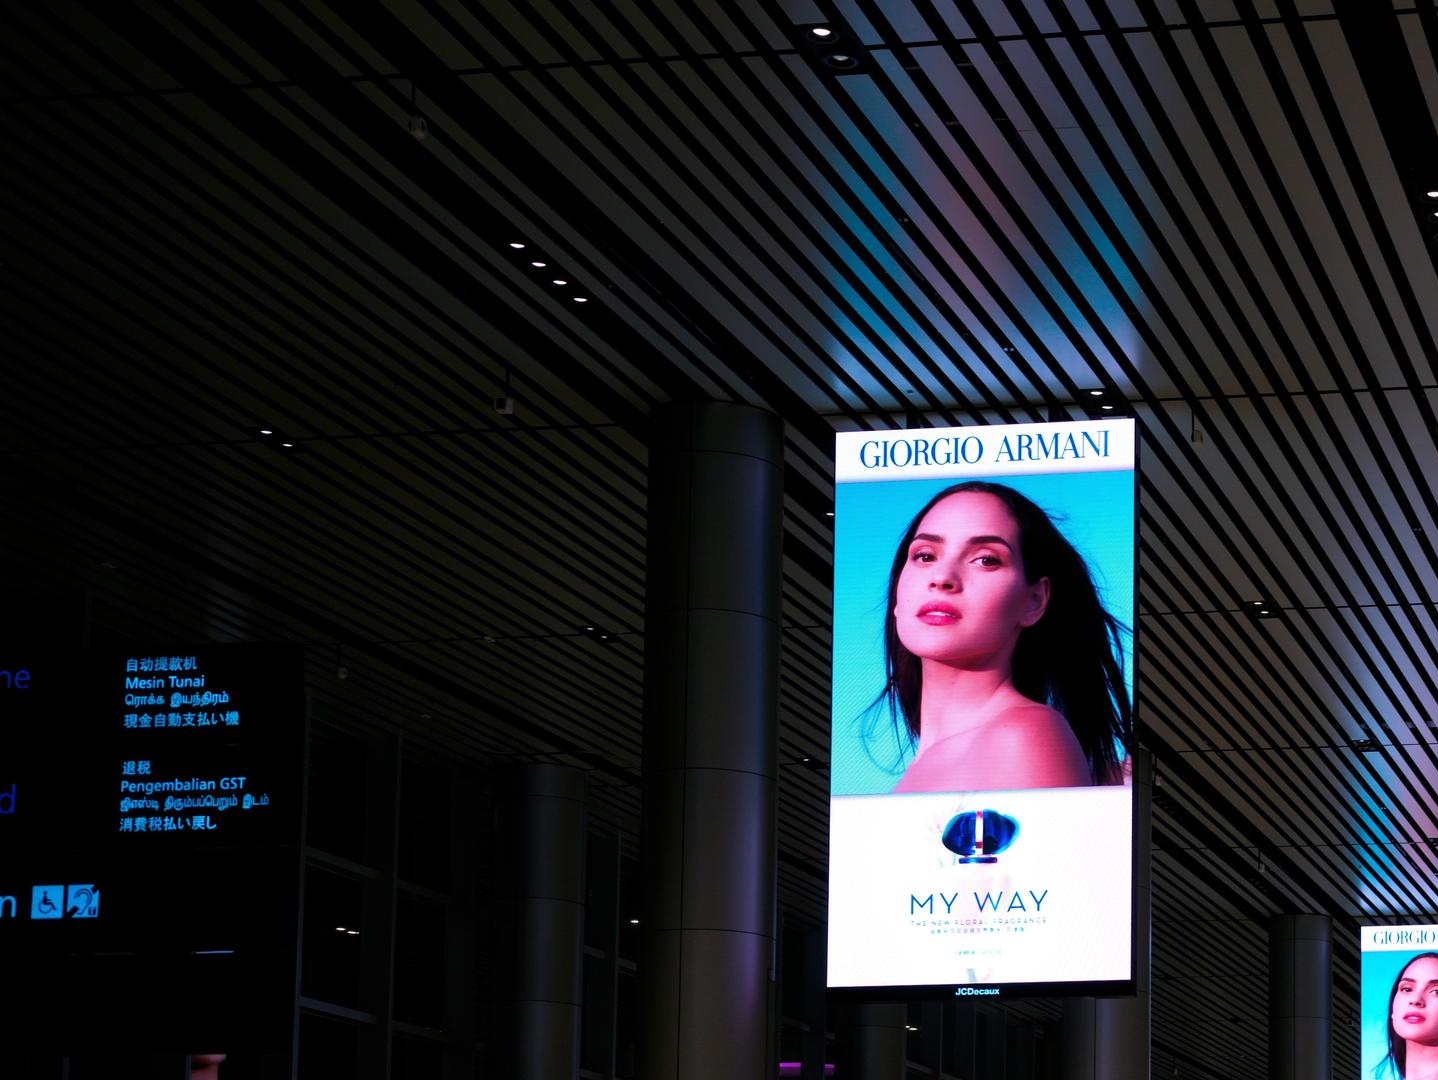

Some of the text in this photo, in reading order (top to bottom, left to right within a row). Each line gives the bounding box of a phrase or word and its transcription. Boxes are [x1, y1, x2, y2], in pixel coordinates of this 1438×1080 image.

[859, 430, 1111, 469] GIORGIO ARMANI
[126, 656, 198, 672] 自动提款机
[125, 674, 205, 689] Mesin Tunai
[123, 711, 240, 728] 現金自動支払い機
[122, 760, 152, 775] 退税
[120, 776, 247, 795] Pengembalian GST
[119, 816, 217, 832] 消費税払い戻し
[910, 889, 1048, 915] MY WAY
[992, 917, 1047, 925] FRAGRANCE
[1373, 930, 1436, 945] GIORGIO
[955, 987, 1000, 996] JCDecaux
